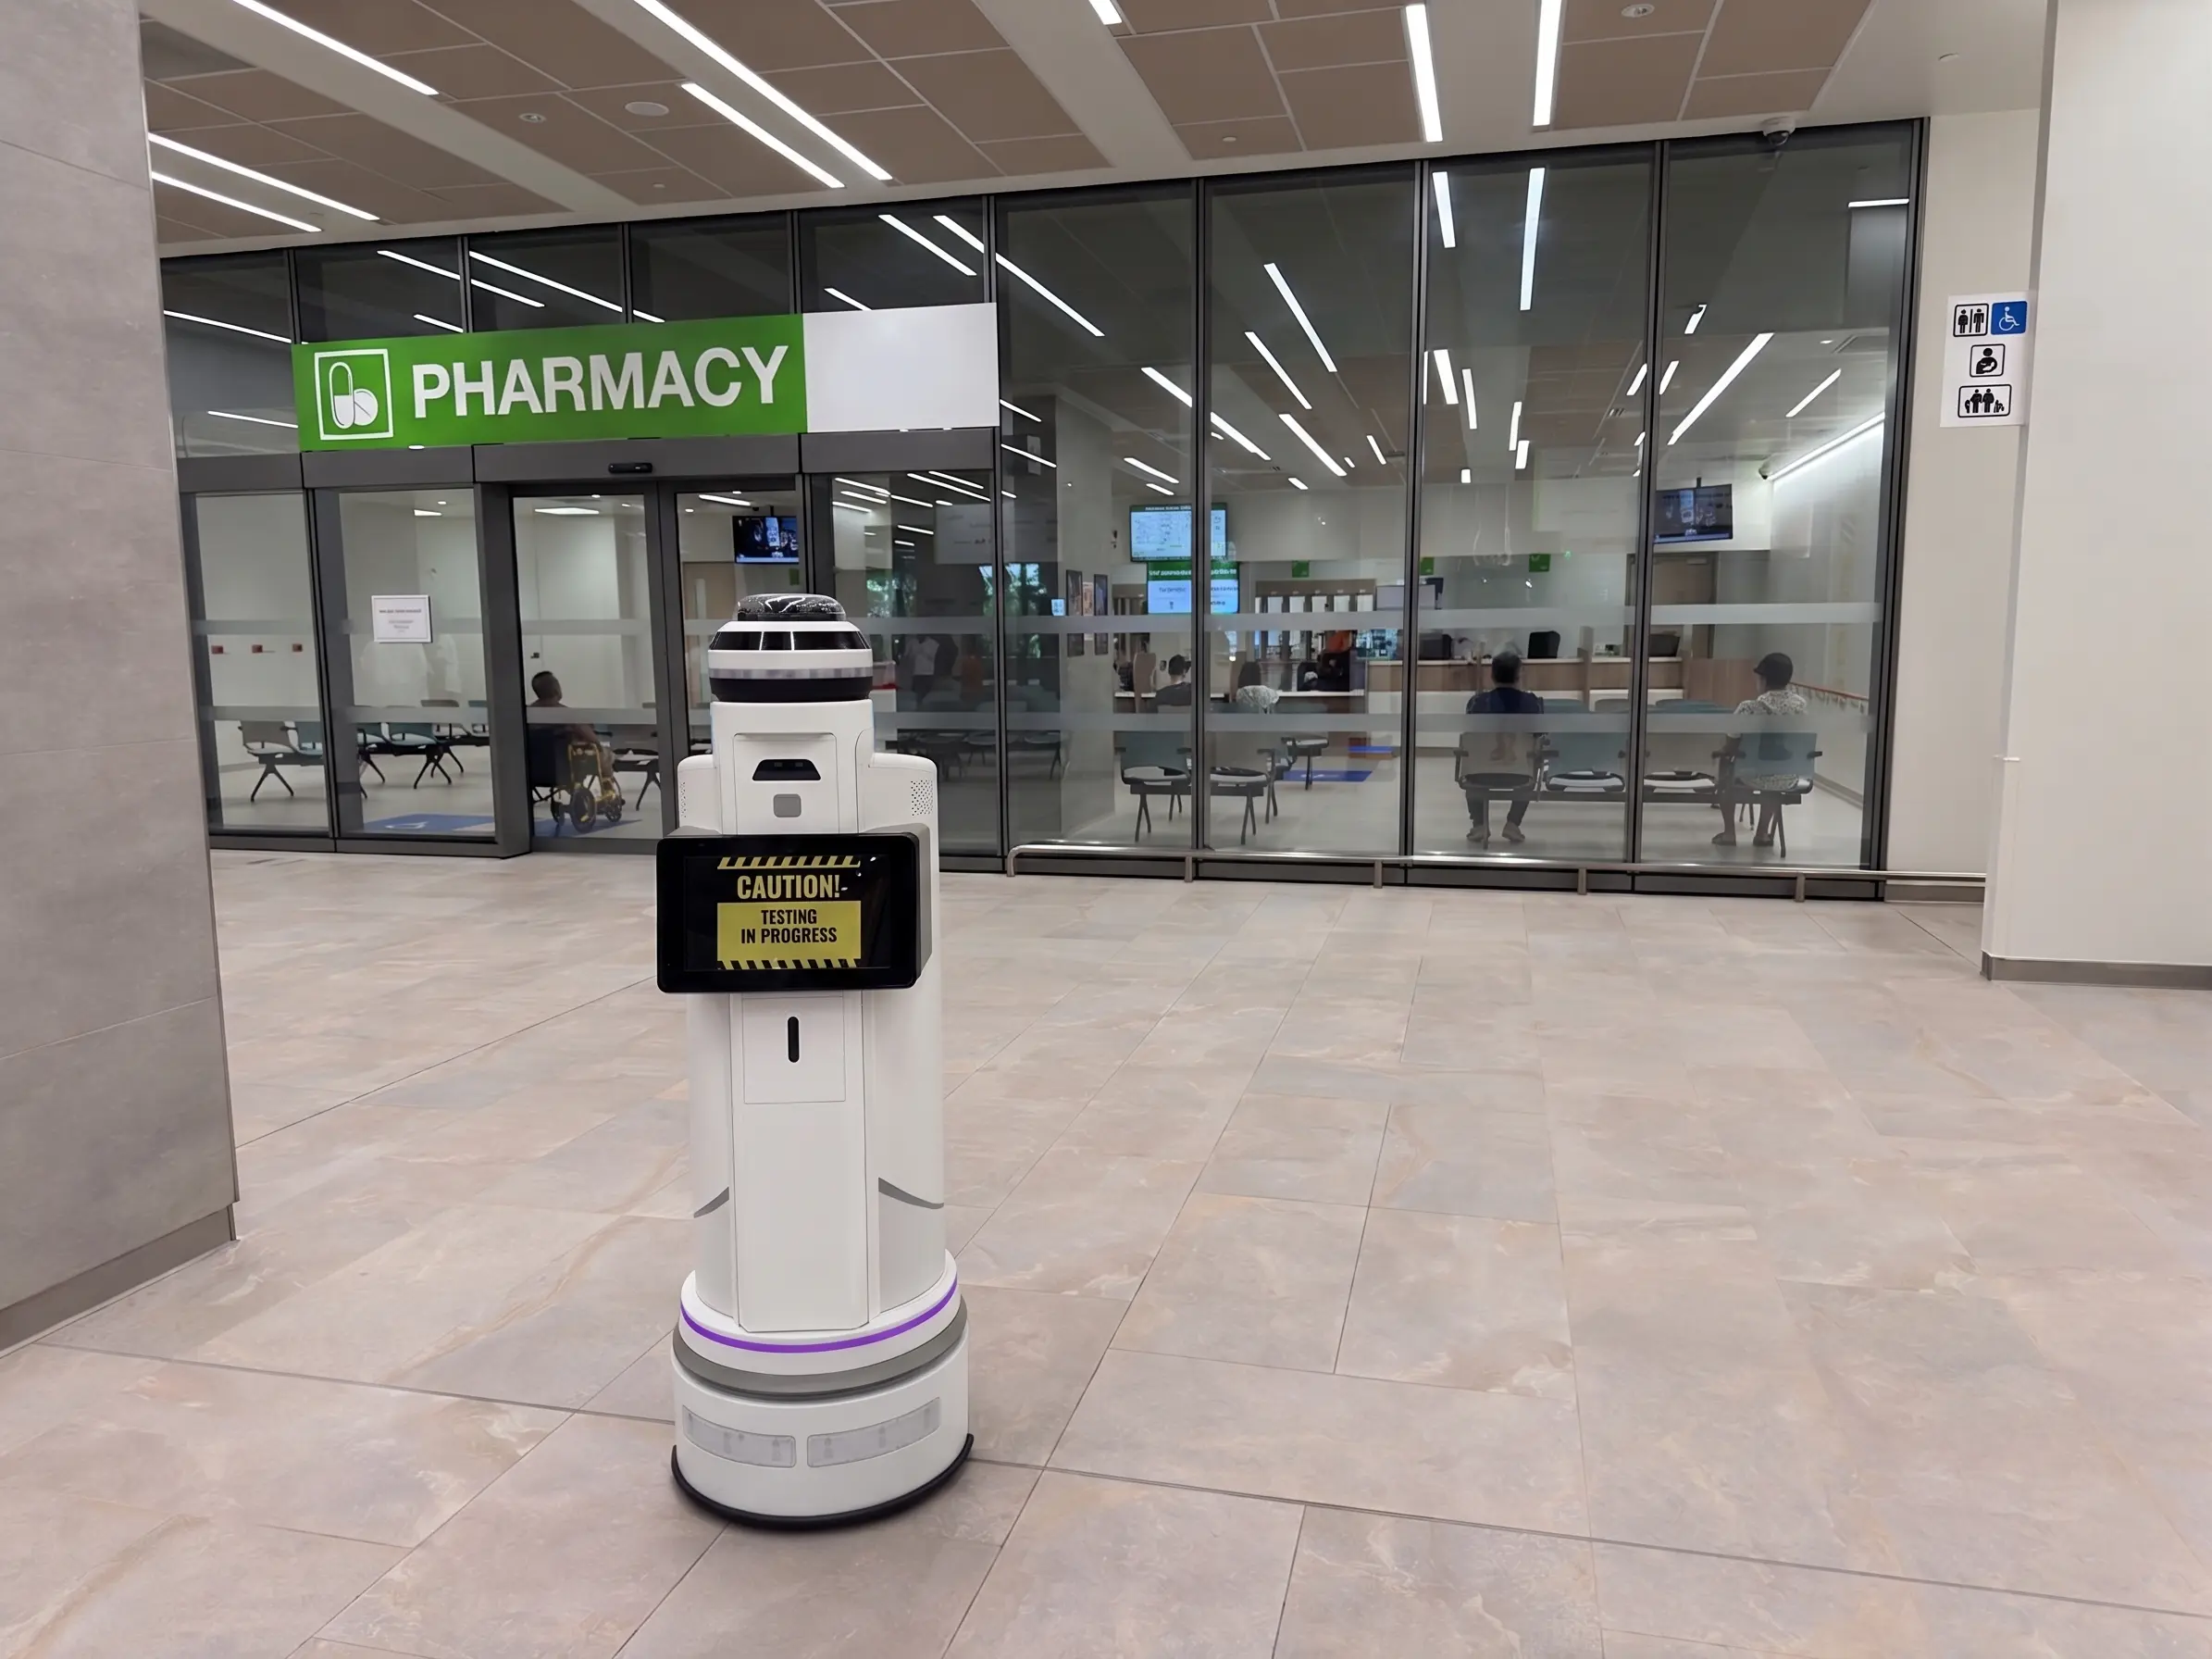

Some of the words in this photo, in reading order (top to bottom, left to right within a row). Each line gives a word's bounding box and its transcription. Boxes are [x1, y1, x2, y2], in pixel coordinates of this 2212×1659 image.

[412, 344, 789, 418] PHARMACY
[737, 874, 840, 900] CAUTION!
[761, 908, 817, 925] TESTING
[741, 929, 756, 943] IN
[761, 927, 838, 943] PROGRESS
